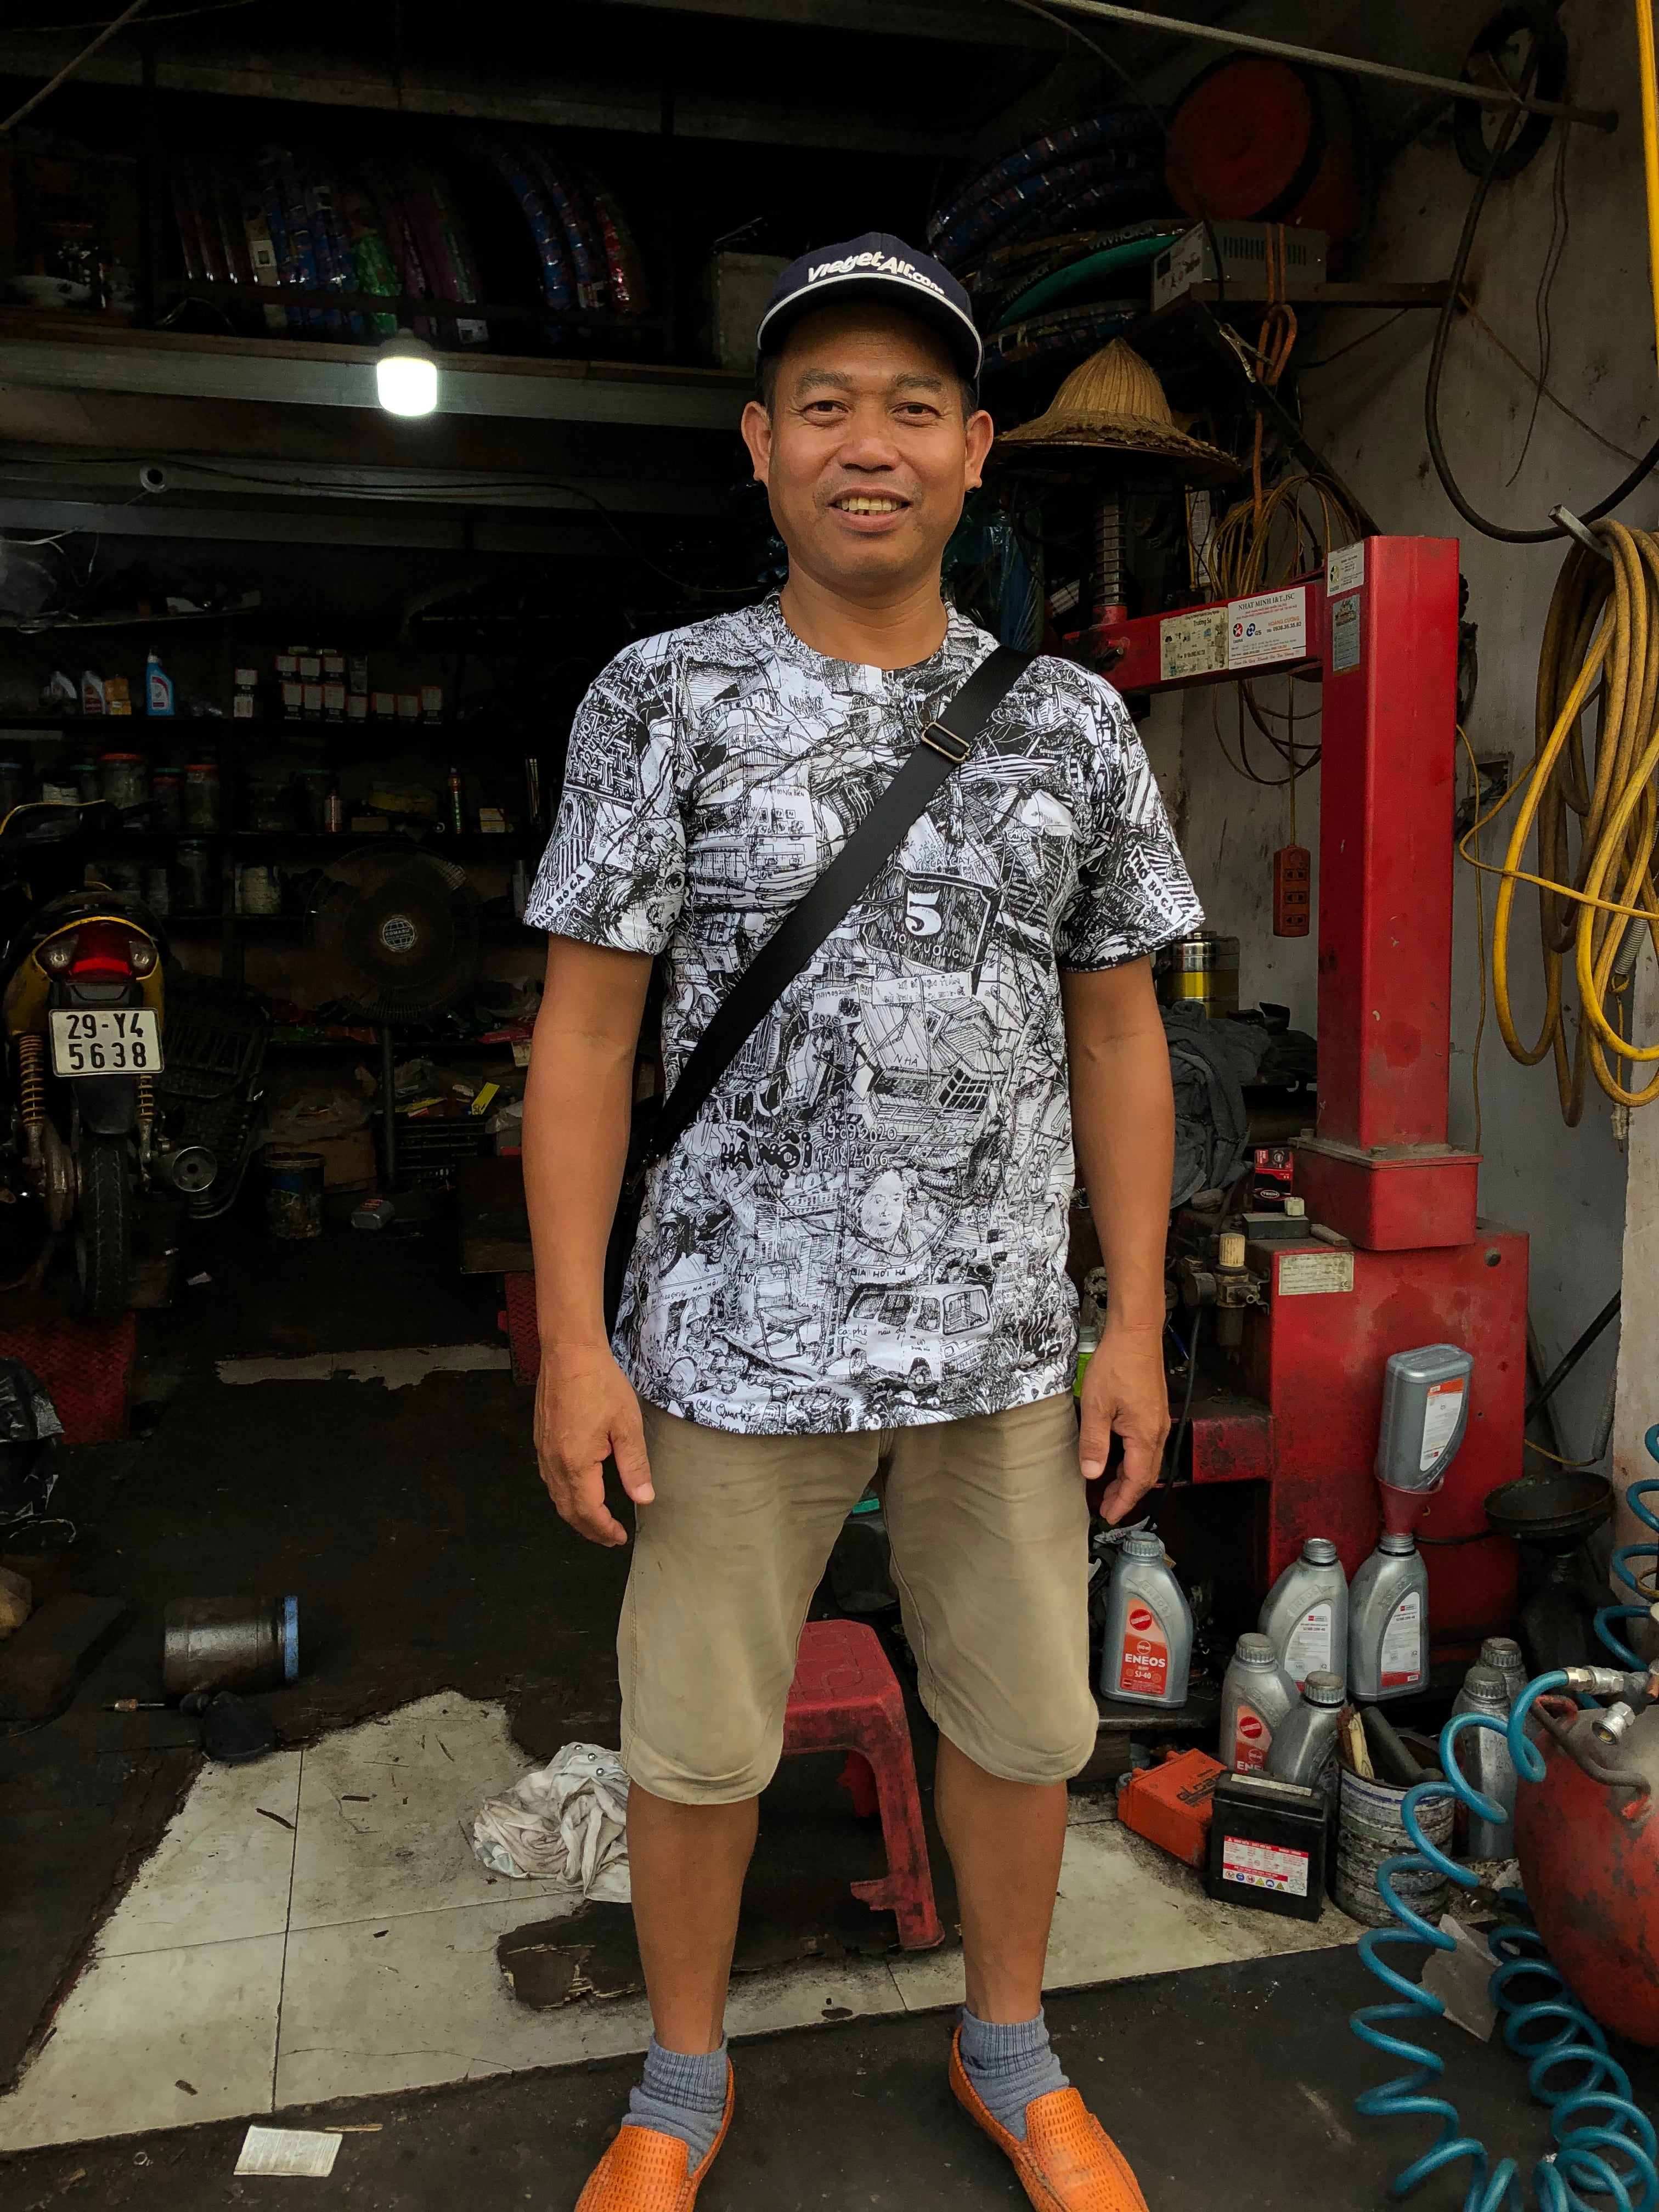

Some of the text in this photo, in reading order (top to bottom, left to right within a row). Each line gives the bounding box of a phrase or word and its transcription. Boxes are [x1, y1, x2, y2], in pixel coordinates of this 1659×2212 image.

[1255, 598, 1271, 607] MINH
[905, 888, 942, 936] 5
[66, 1013, 144, 1040] 29-Y4
[811, 1011, 842, 1029] 2020
[69, 1042, 146, 1070] 5638
[860, 1124, 897, 1142] 2020
[696, 1398, 712, 1413] Old
[1125, 1653, 1166, 1668] ENEOS
